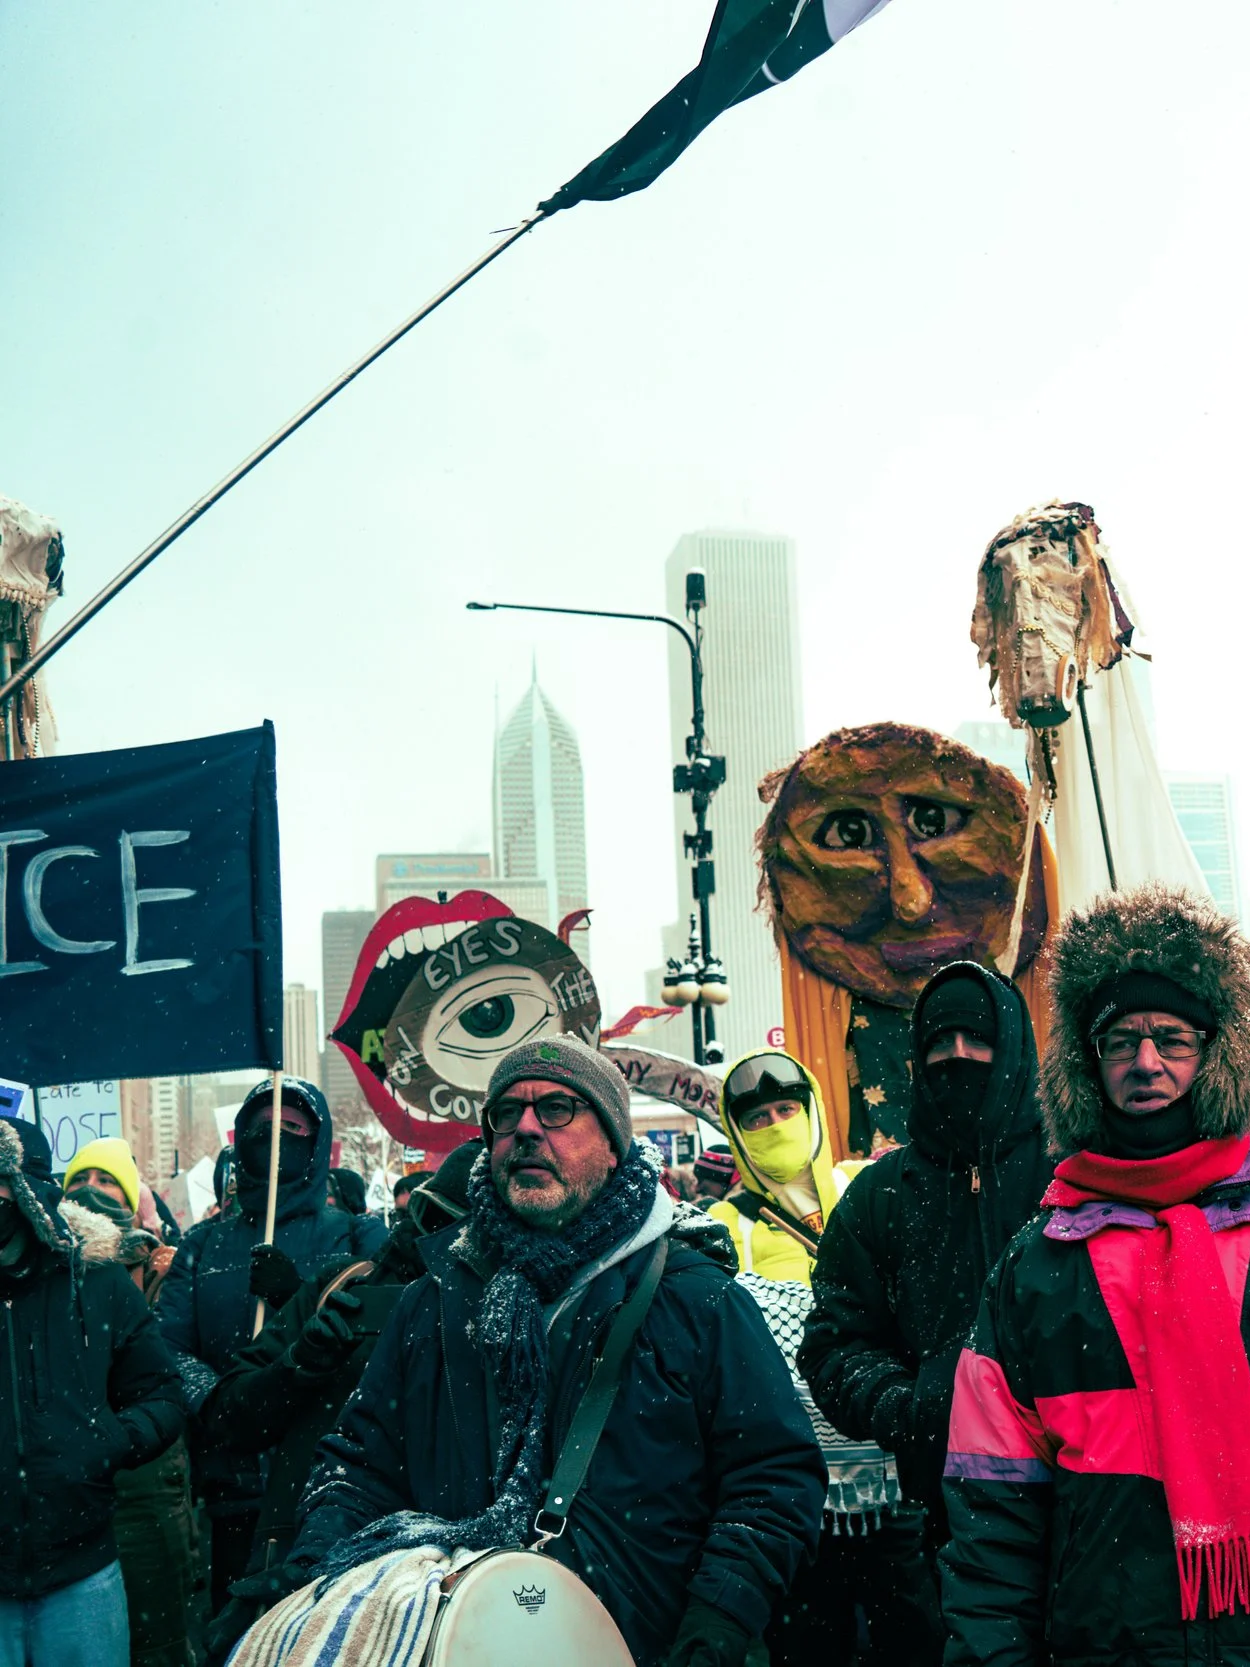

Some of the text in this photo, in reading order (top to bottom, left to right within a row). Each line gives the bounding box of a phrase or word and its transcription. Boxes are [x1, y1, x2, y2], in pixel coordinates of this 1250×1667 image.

[424, 920, 523, 990] EYES
[551, 968, 595, 1011] THE
[519, 1595, 543, 1603] REMO
